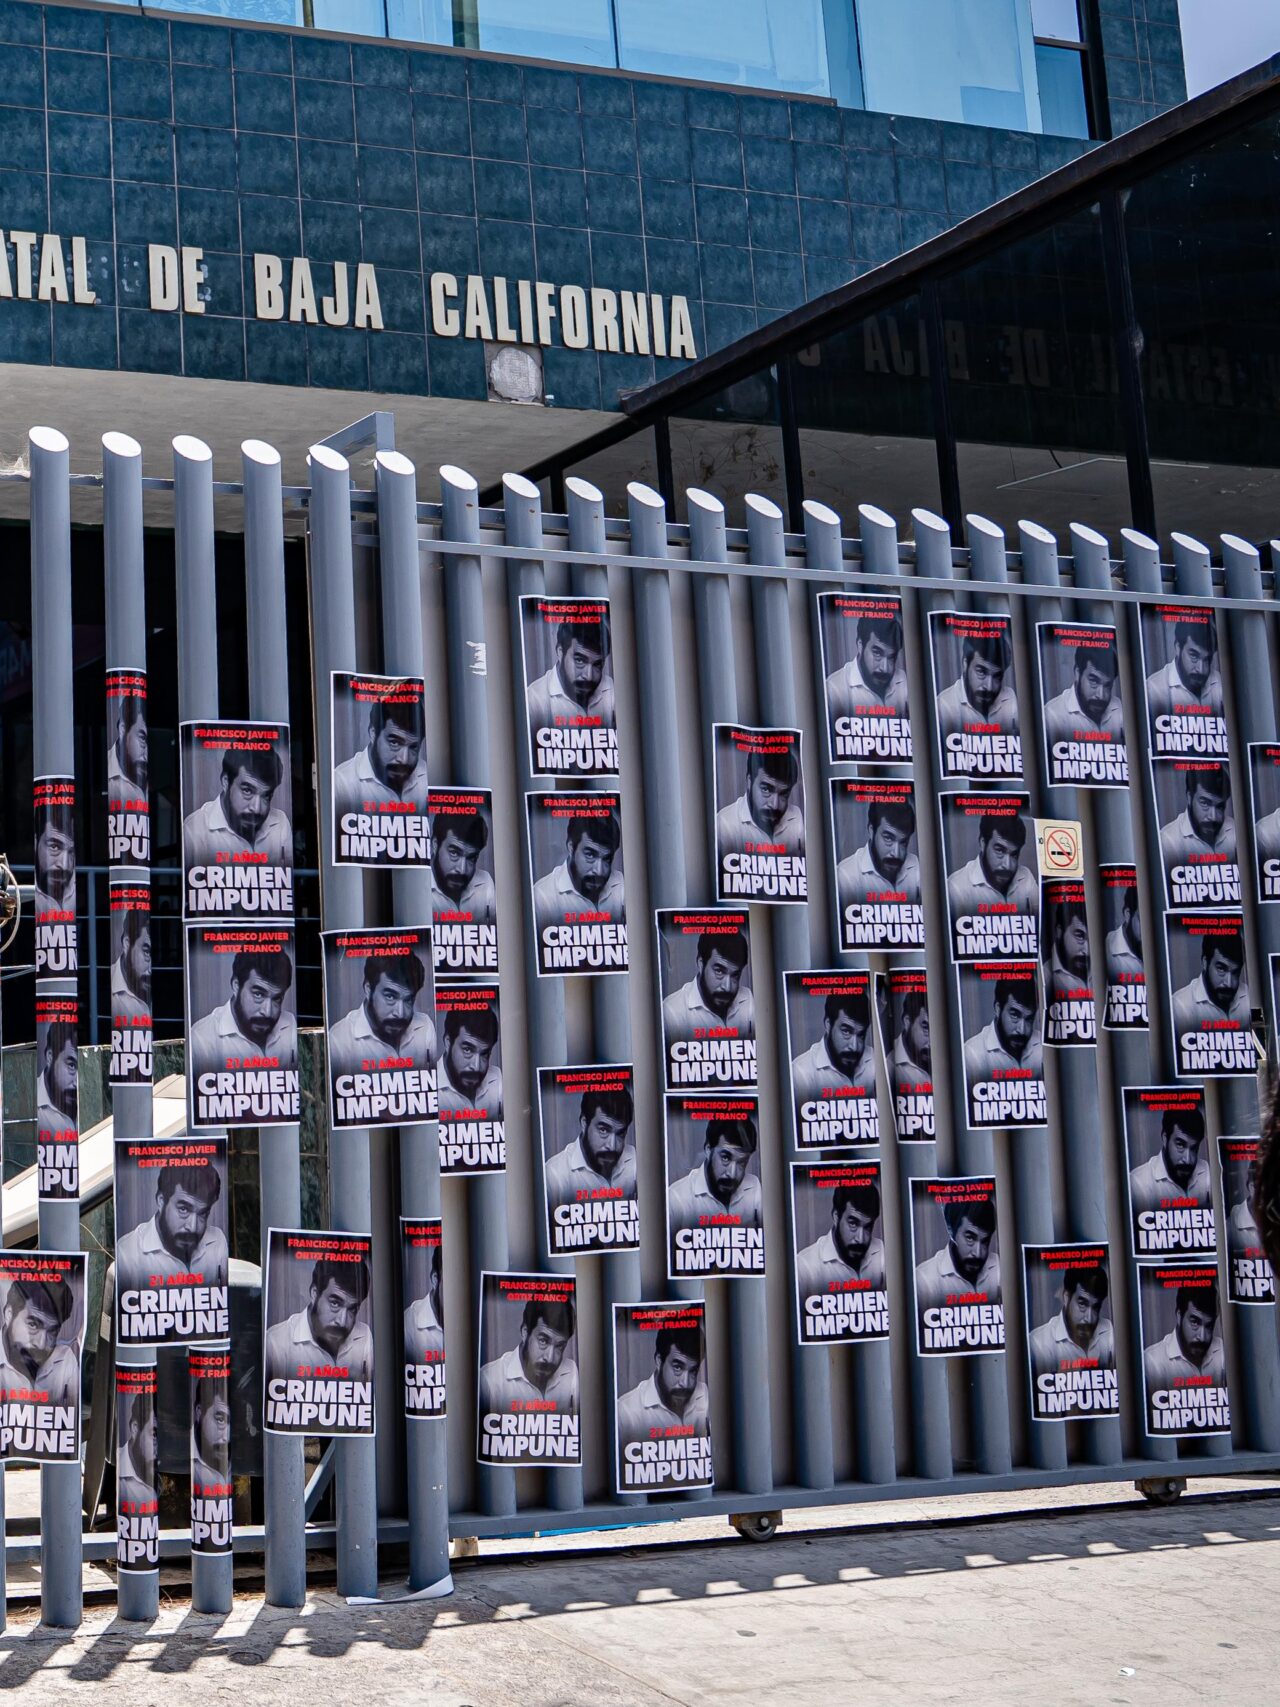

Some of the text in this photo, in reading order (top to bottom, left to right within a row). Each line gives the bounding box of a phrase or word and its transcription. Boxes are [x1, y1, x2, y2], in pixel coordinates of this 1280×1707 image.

[148, 244, 206, 314] DE
[254, 253, 383, 330] BAJA
[430, 271, 697, 360] CALIFORNIA
[722, 853, 805, 876] CRIMEN
[188, 866, 291, 887] CRIMEN
[723, 873, 807, 896] IMPUNE
[189, 889, 292, 910] IMPUNE
[955, 915, 1035, 934] CRIMEN
[204, 932, 288, 940] FRANCISCO JAVIER
[956, 935, 1037, 953] IMPUNE
[243, 944, 281, 952] FRANCO
[226, 1056, 278, 1068] 21 AÑOS
[197, 1070, 299, 1095] CRIMEN
[199, 1093, 300, 1118] IMPUNE
[675, 1227, 762, 1248] CRIMEN
[676, 1248, 764, 1269] IMPUNE
[121, 1286, 227, 1313] CRIMEN
[121, 1310, 228, 1337] IMPUNE
[268, 1378, 371, 1404] CRIMEN
[267, 1402, 371, 1427] IMPUNE
[483, 1413, 578, 1435] CRIMEN
[482, 1435, 578, 1456] IMPUNE
